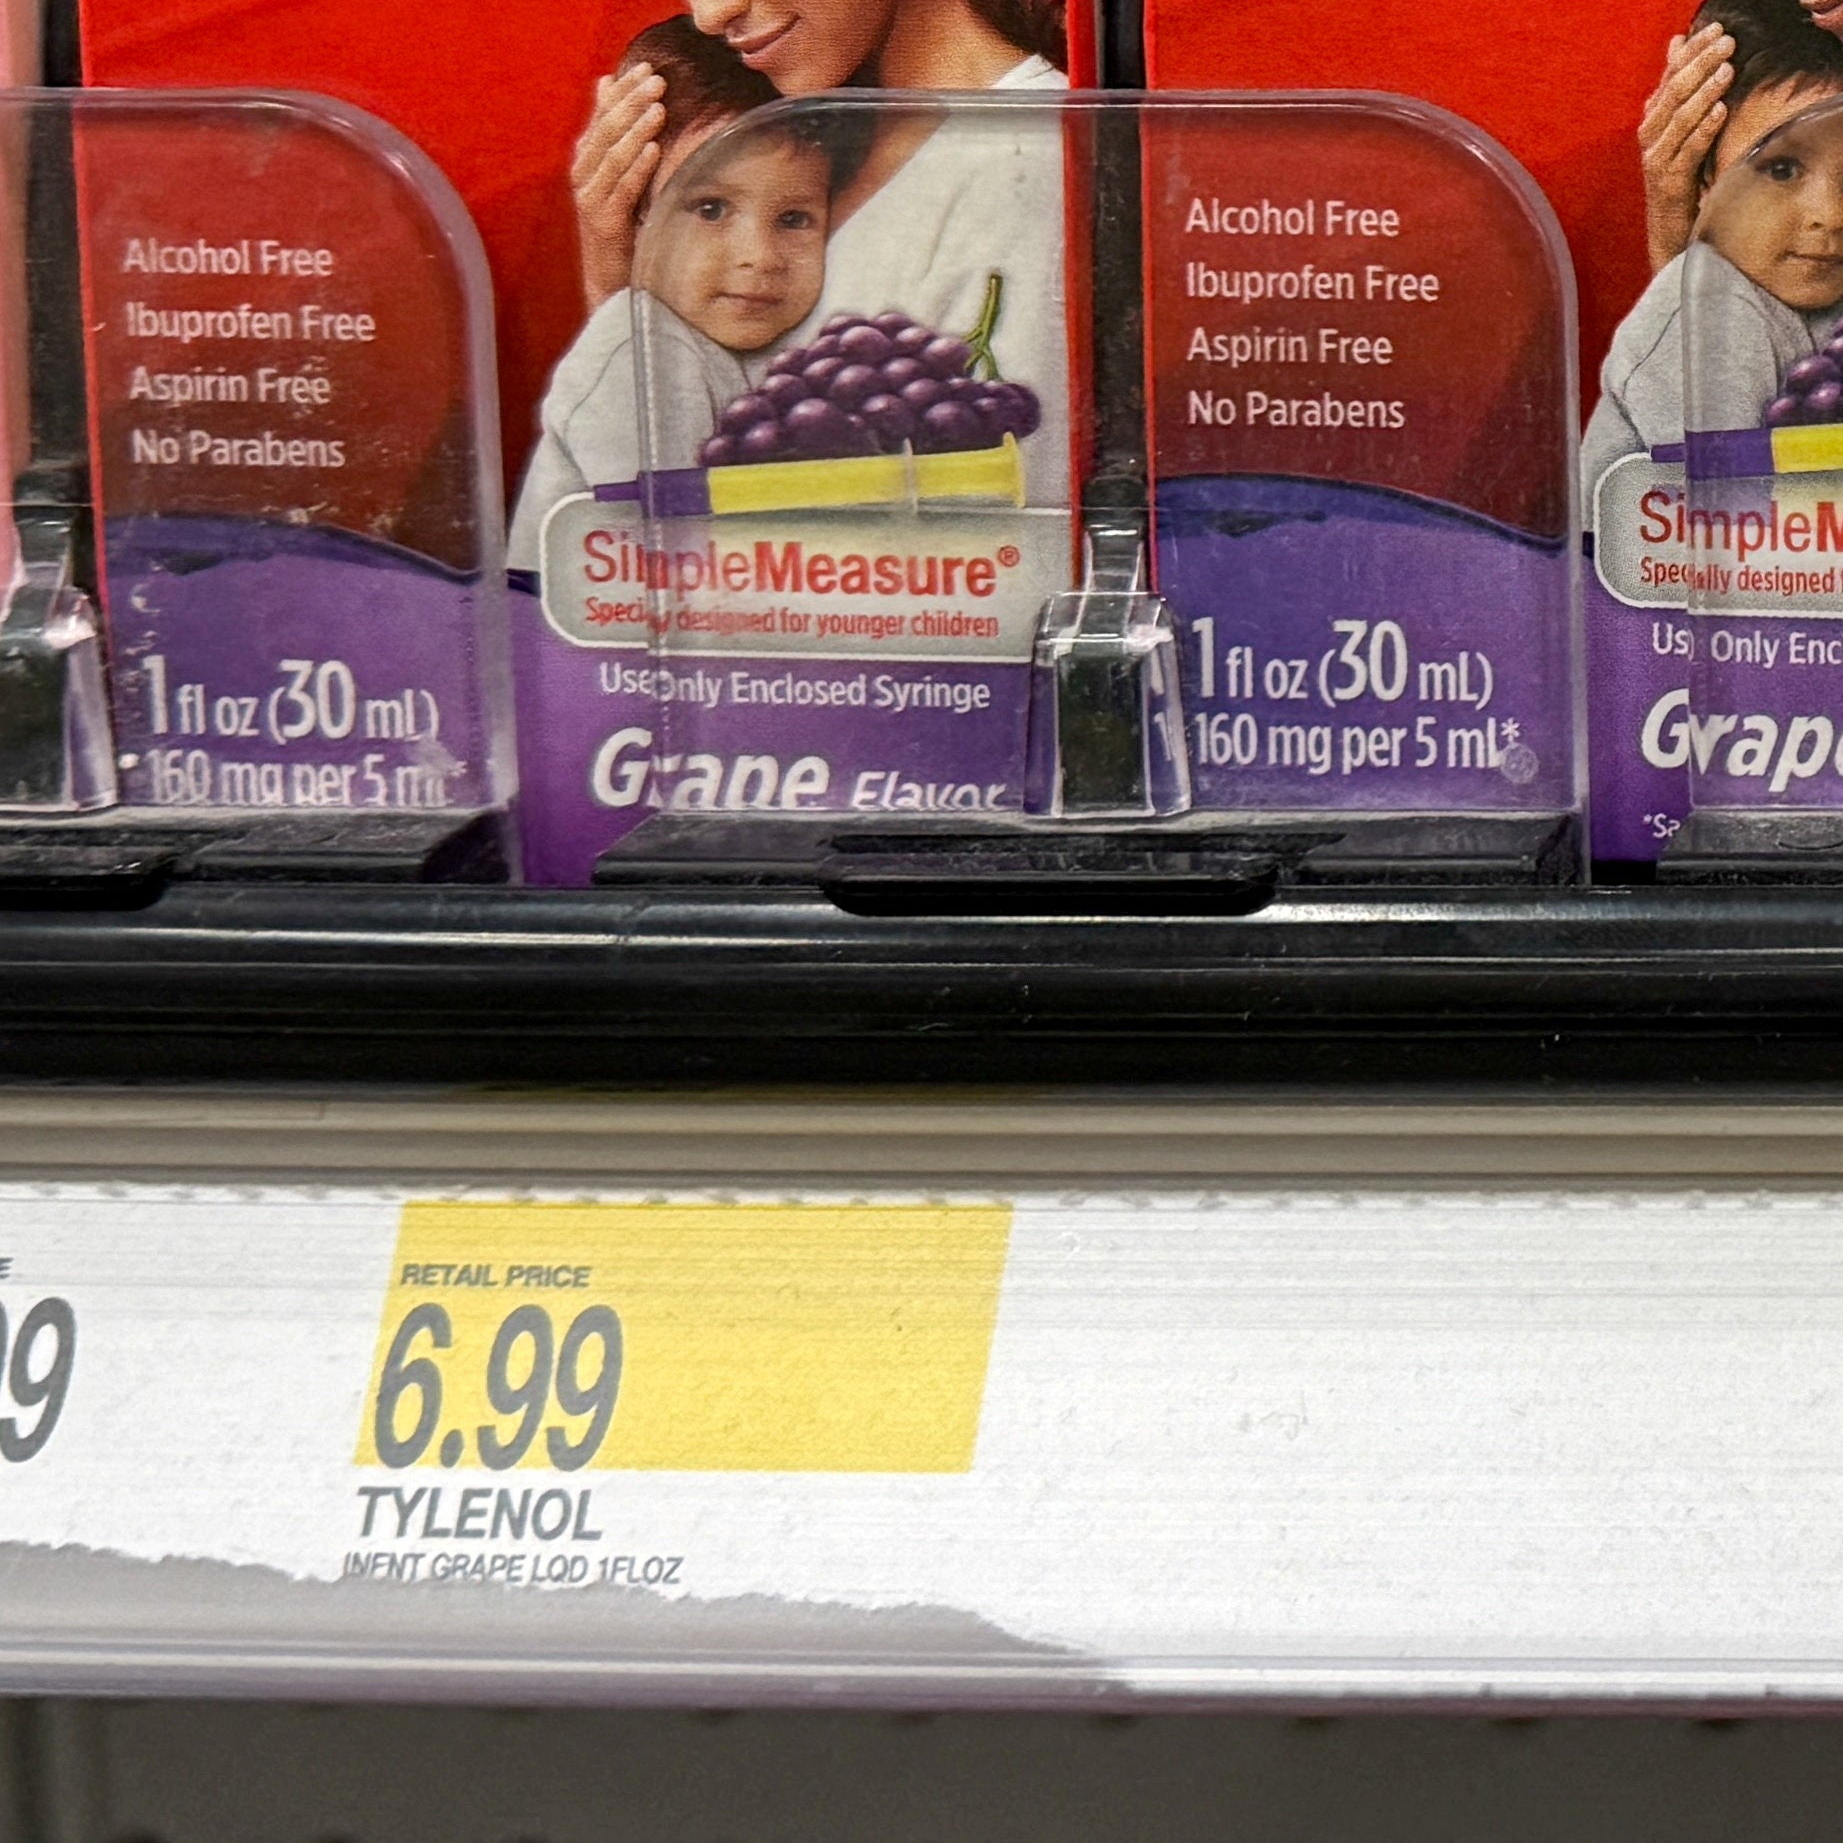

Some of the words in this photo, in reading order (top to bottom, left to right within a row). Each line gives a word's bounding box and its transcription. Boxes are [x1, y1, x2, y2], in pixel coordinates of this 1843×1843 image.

[1185, 197, 1314, 235] Alcohol
[1325, 200, 1400, 237] Free
[1186, 261, 1355, 305] Ibuprofen
[1365, 265, 1440, 302] Free
[1186, 326, 1309, 369] Aspirin
[1318, 328, 1394, 365] Free
[1187, 390, 1237, 426] No
[1246, 390, 1406, 429] Parabens
[142, 655, 168, 735] 1
[214, 696, 260, 737] oz
[400, 1263, 499, 1289] RETAIL
[504, 1264, 592, 1290] PRICE
[374, 1302, 623, 1472] 6.99
[356, 1486, 603, 1542] TYLENOL
[431, 1552, 527, 1583] GRAPE
[529, 1554, 590, 1585] LQD
[597, 1555, 686, 1586] 1FLOZ
